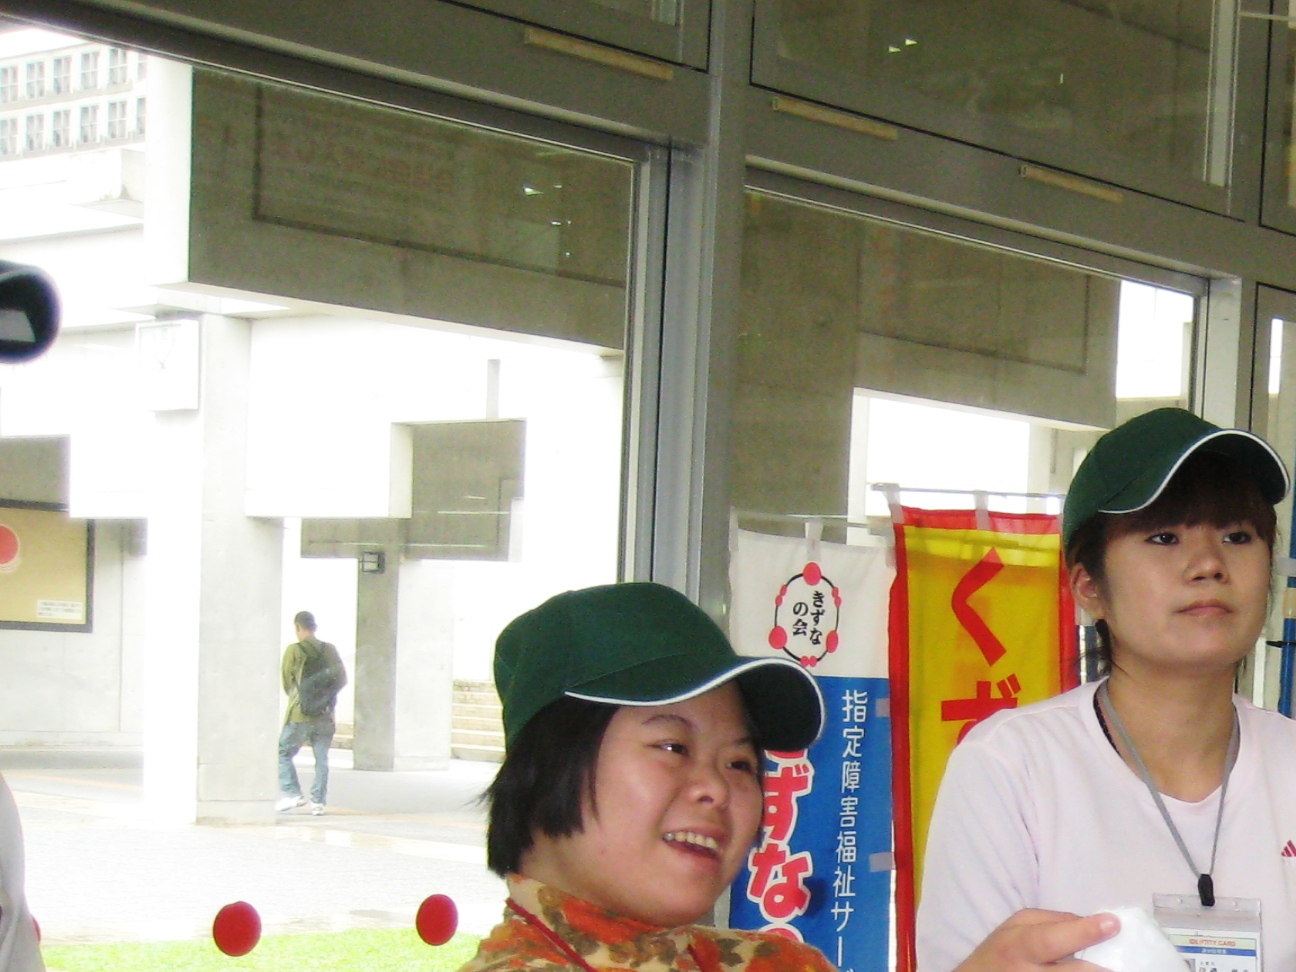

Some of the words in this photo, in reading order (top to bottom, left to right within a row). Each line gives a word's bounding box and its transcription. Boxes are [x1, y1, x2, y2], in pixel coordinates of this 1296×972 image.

[792, 601, 809, 637] の会
[810, 590, 825, 646] きずな
[748, 750, 813, 943] ずな
